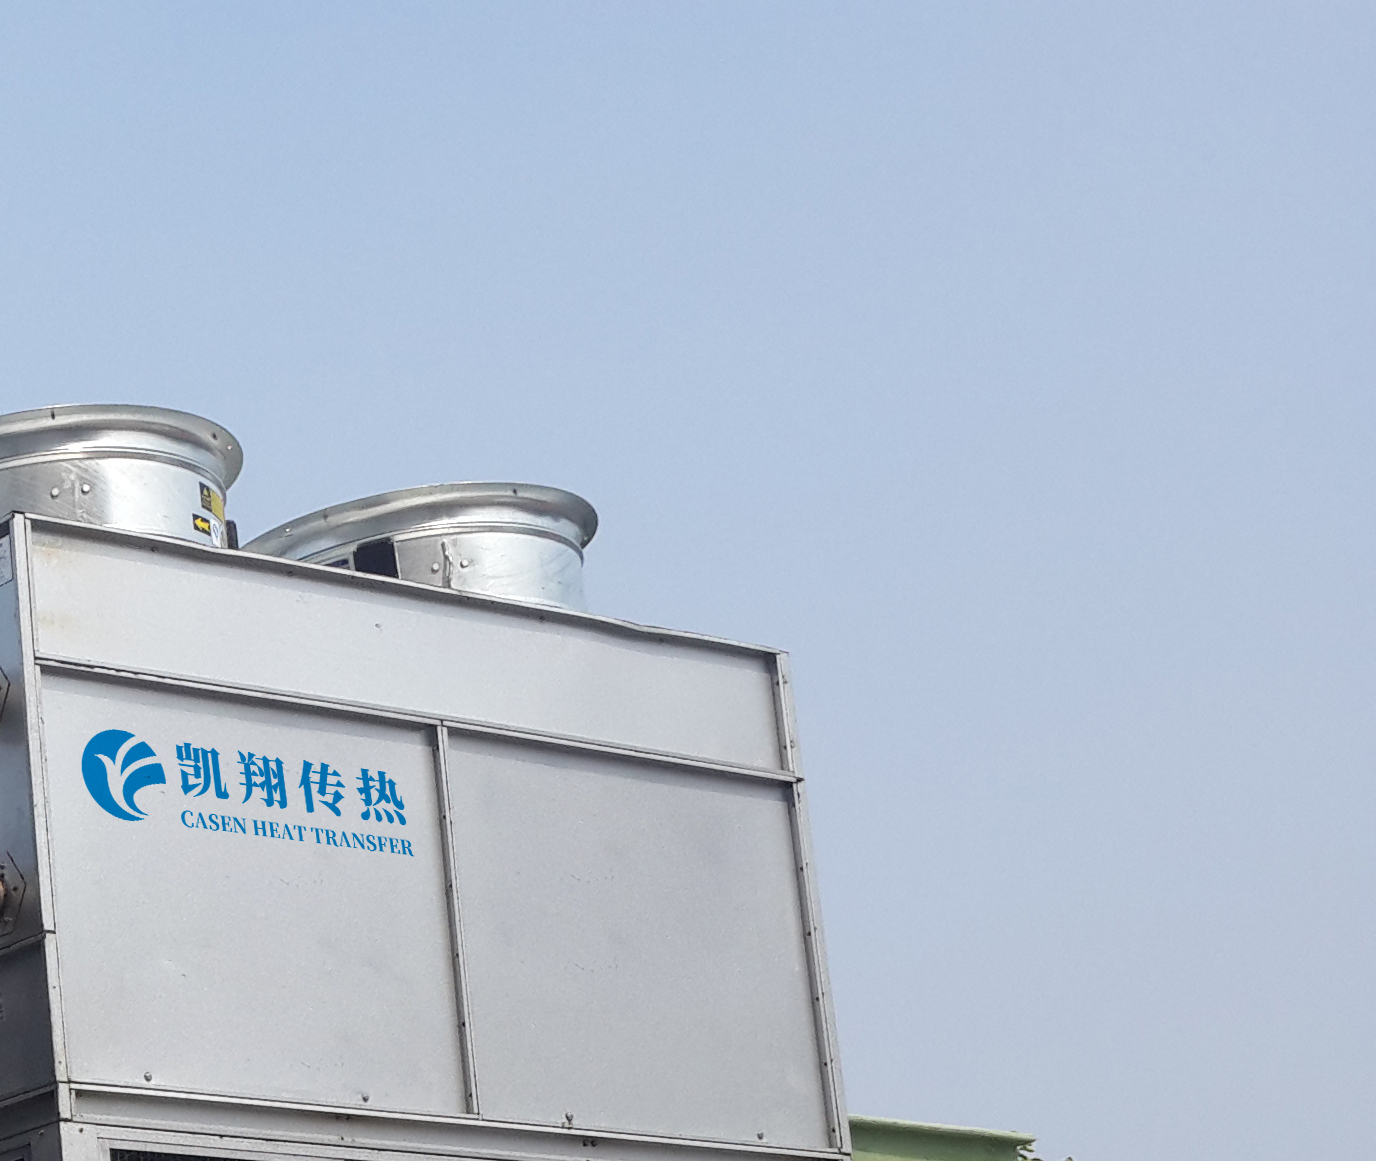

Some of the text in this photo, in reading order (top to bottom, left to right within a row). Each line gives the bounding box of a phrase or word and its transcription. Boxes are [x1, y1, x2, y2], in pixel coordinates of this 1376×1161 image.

[175, 741, 407, 826] 凯翔传热
[180, 809, 415, 857] CASEN HEAT TRANSFER
